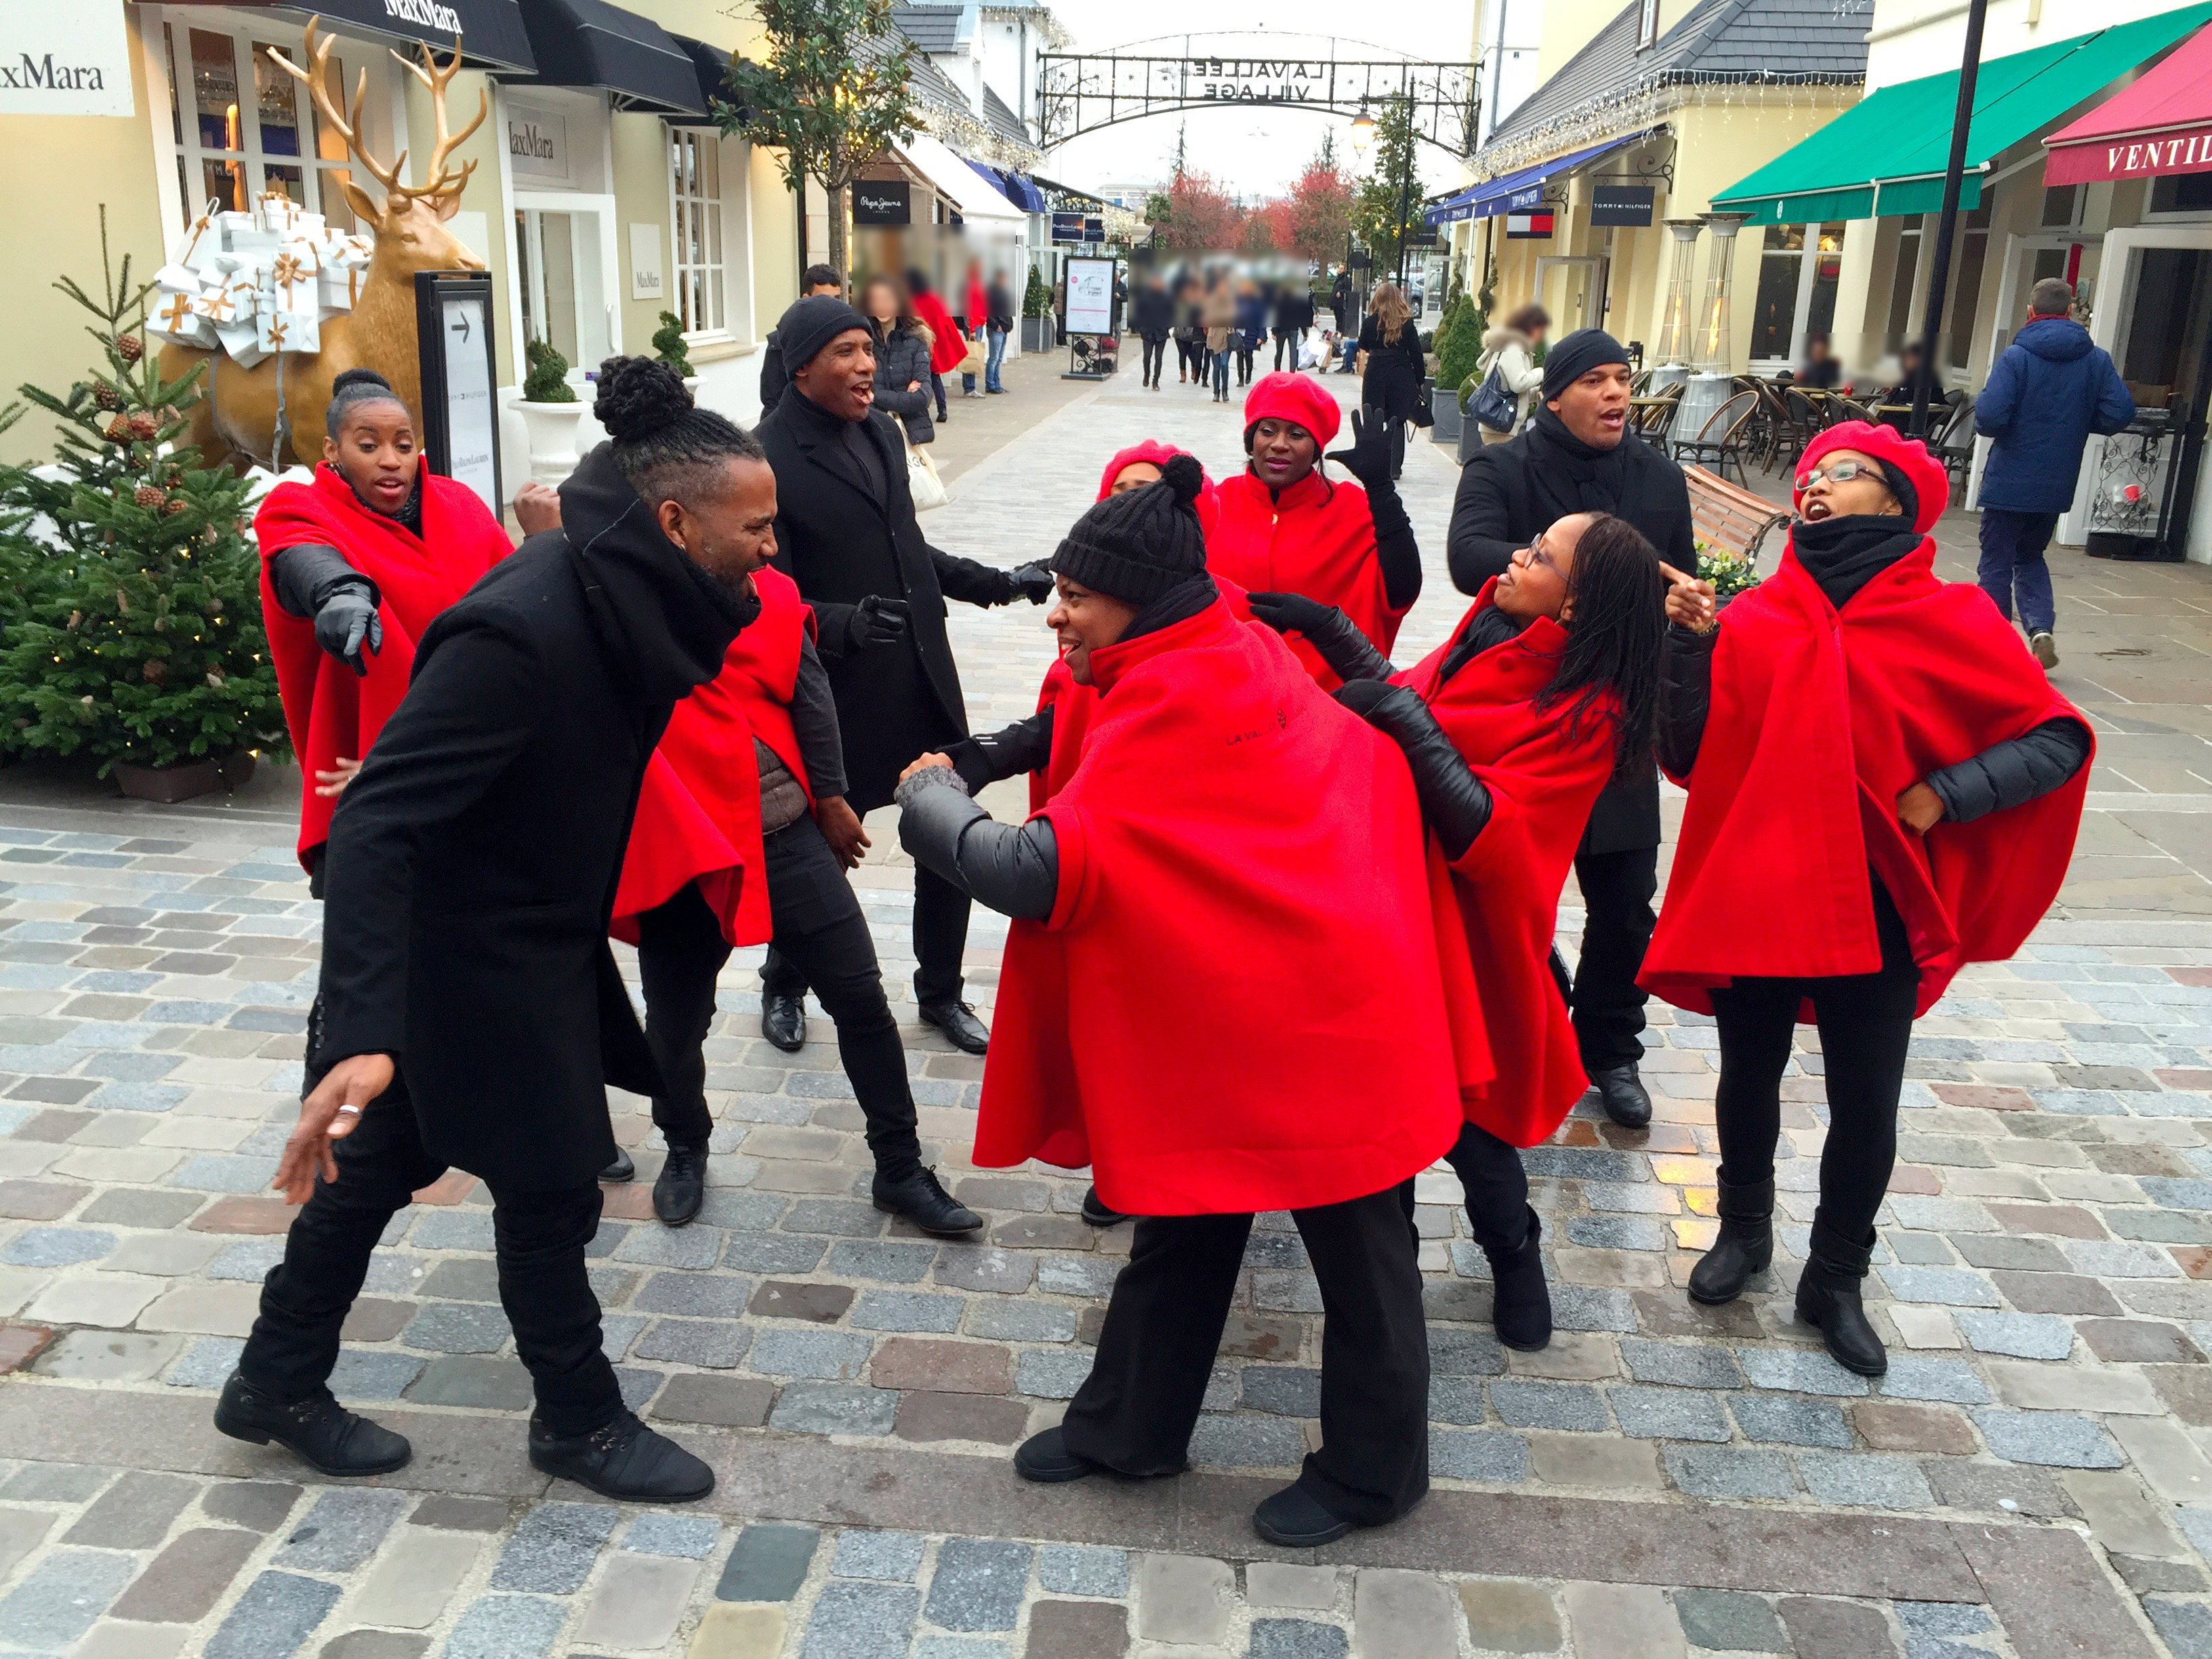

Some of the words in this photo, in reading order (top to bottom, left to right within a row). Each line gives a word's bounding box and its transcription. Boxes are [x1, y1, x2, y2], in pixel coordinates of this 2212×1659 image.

[0, 52, 104, 90] xMara
[860, 196, 879, 209] Pepe
[878, 197, 902, 210] Jeans
